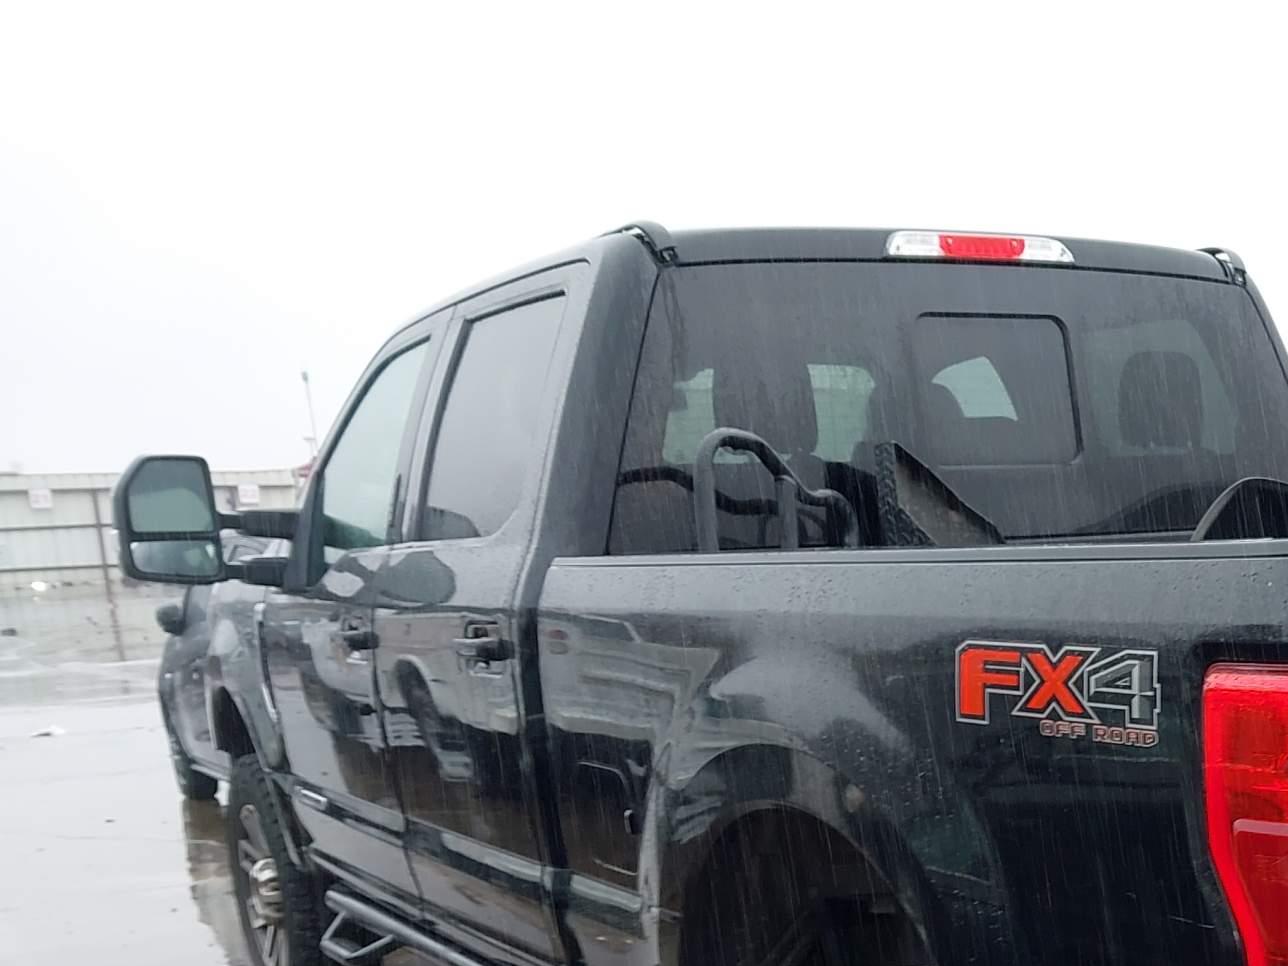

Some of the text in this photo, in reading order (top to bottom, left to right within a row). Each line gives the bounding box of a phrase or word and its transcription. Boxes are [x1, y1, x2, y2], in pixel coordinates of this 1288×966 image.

[955, 640, 1161, 730] FX4
[1039, 719, 1160, 747] OFF ROAD
